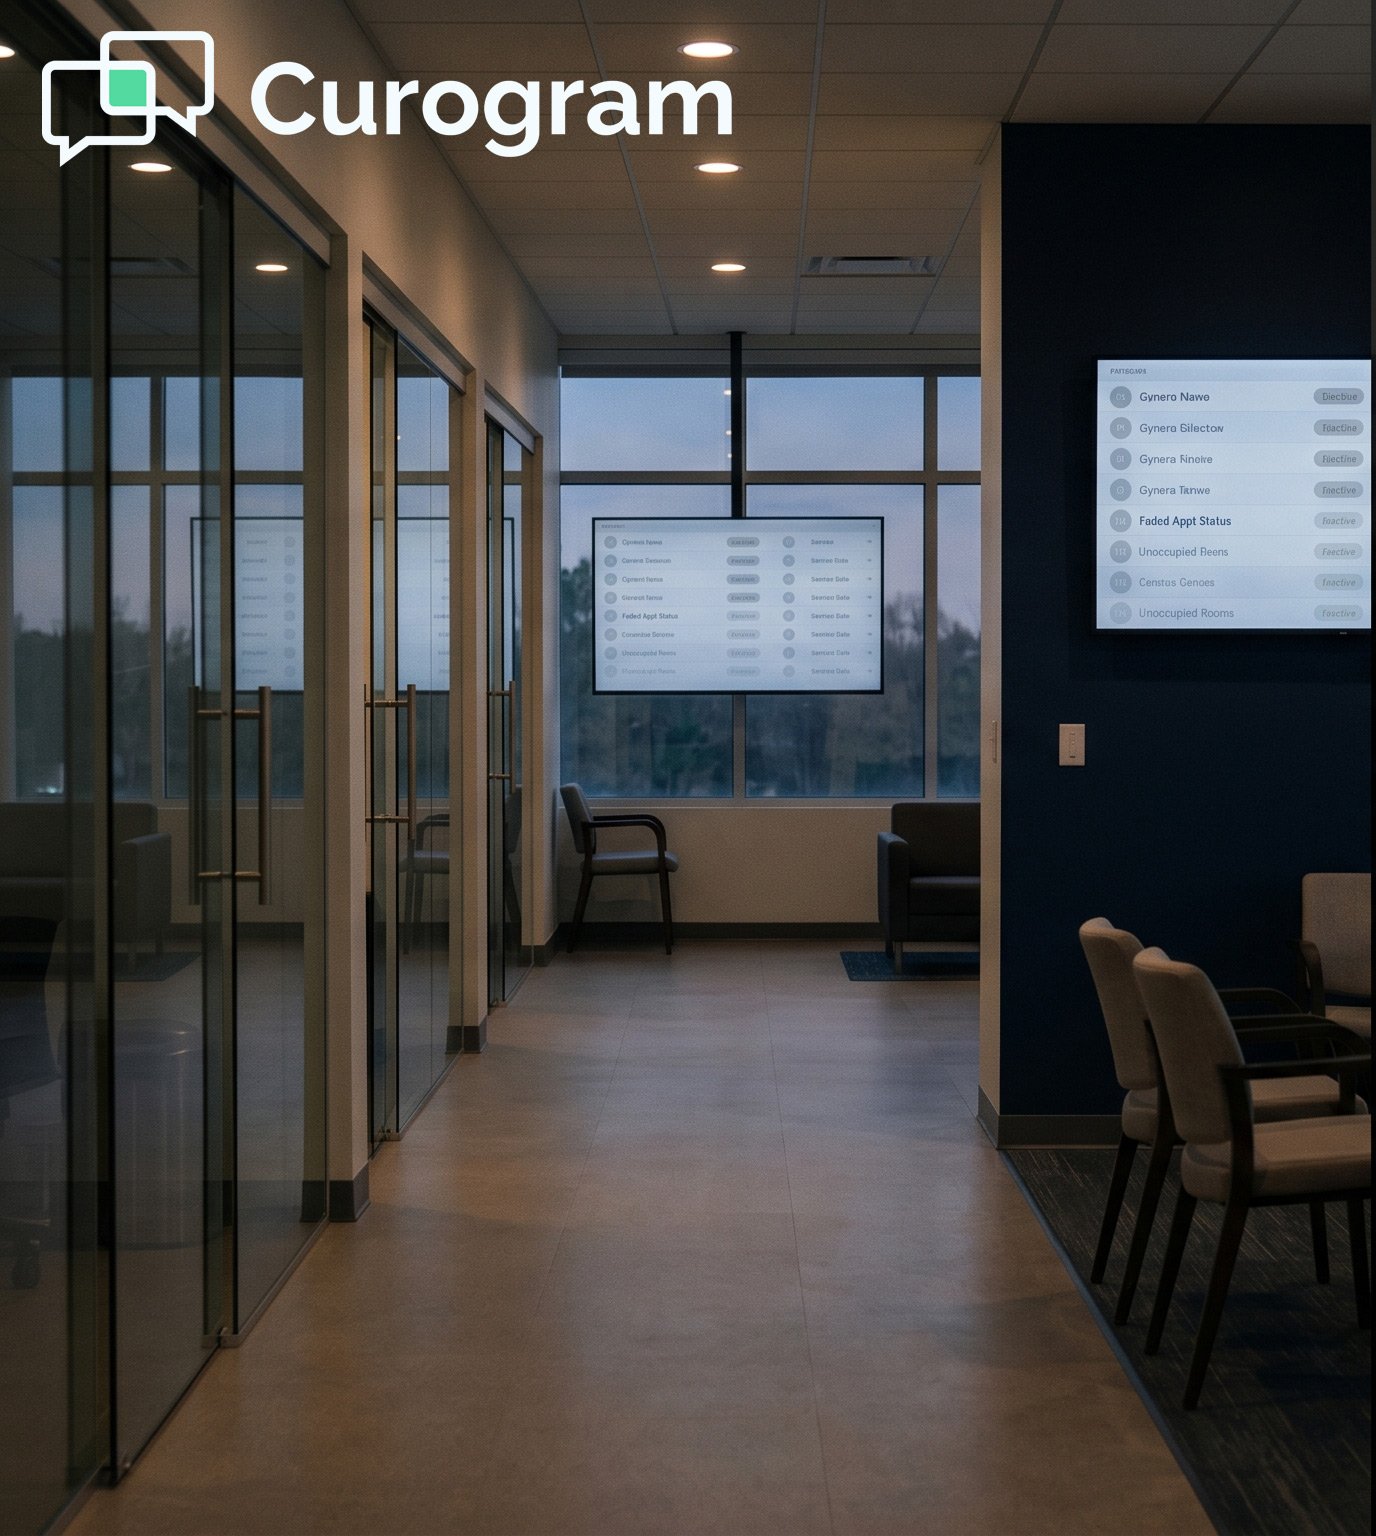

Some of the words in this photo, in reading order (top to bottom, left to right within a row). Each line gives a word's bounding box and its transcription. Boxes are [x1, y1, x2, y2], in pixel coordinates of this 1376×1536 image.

[1139, 516, 1170, 526] Faded
[1172, 516, 1197, 528] Appt
[1199, 516, 1232, 526] Status
[1138, 547, 1197, 559] Unoccupied
[1139, 608, 1198, 620] Unoccupied
[1201, 608, 1235, 618] Rooms
